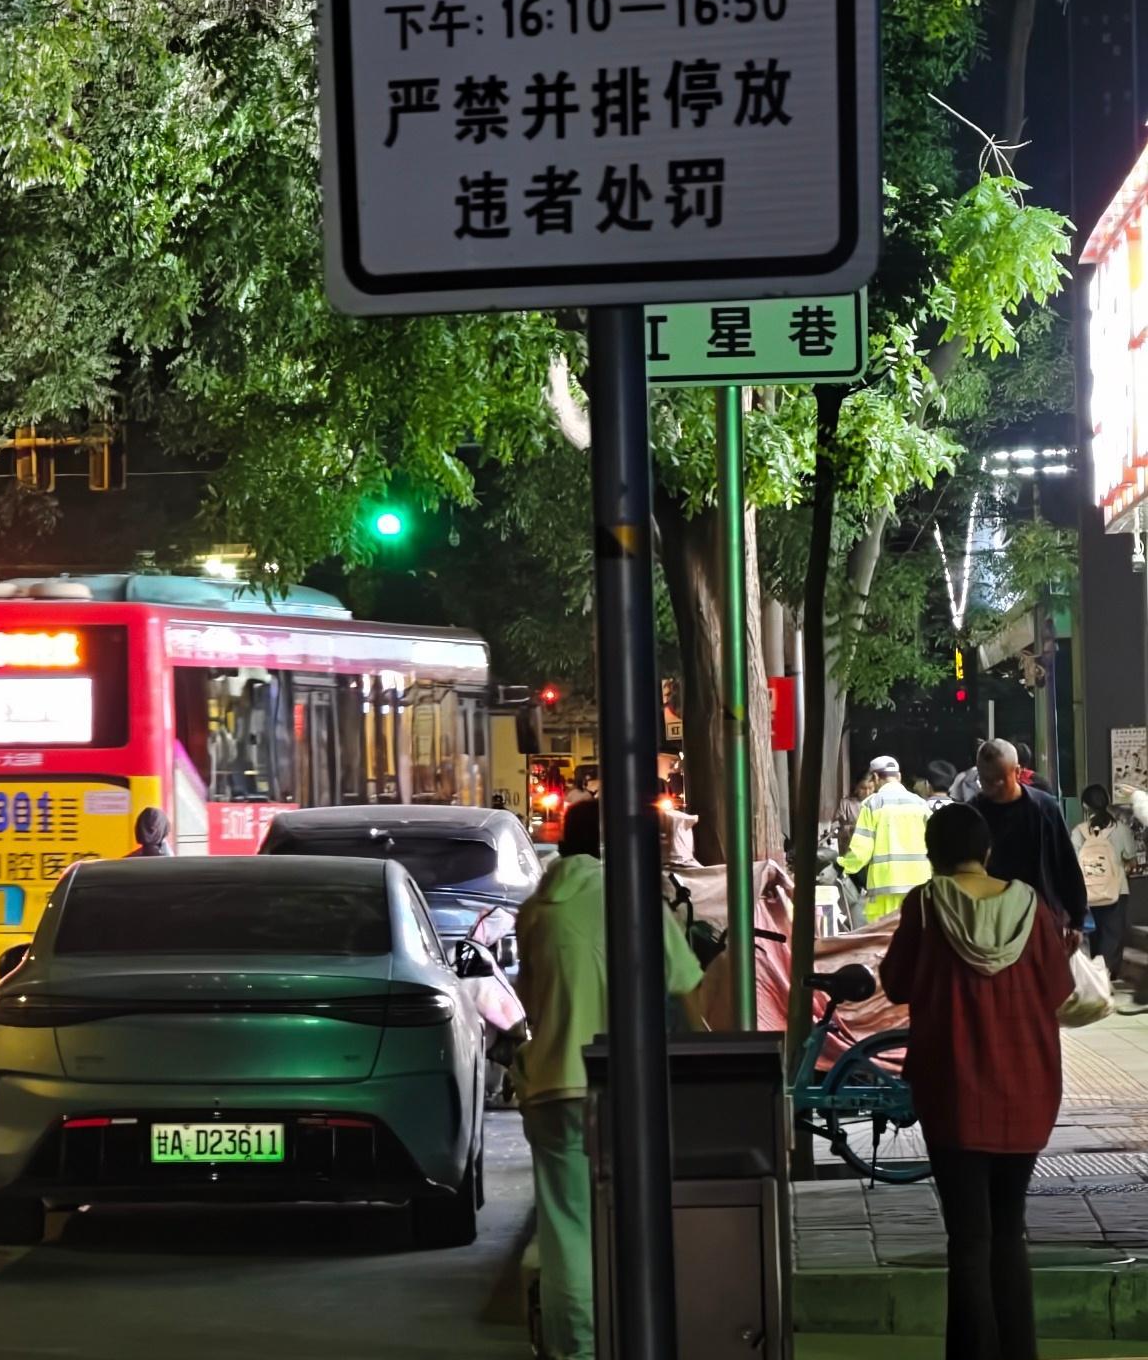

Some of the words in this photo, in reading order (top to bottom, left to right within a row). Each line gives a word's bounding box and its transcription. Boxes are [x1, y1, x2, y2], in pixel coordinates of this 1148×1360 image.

[383, 57, 793, 148] 严禁并排停放
[454, 157, 725, 240] 违者处罚
